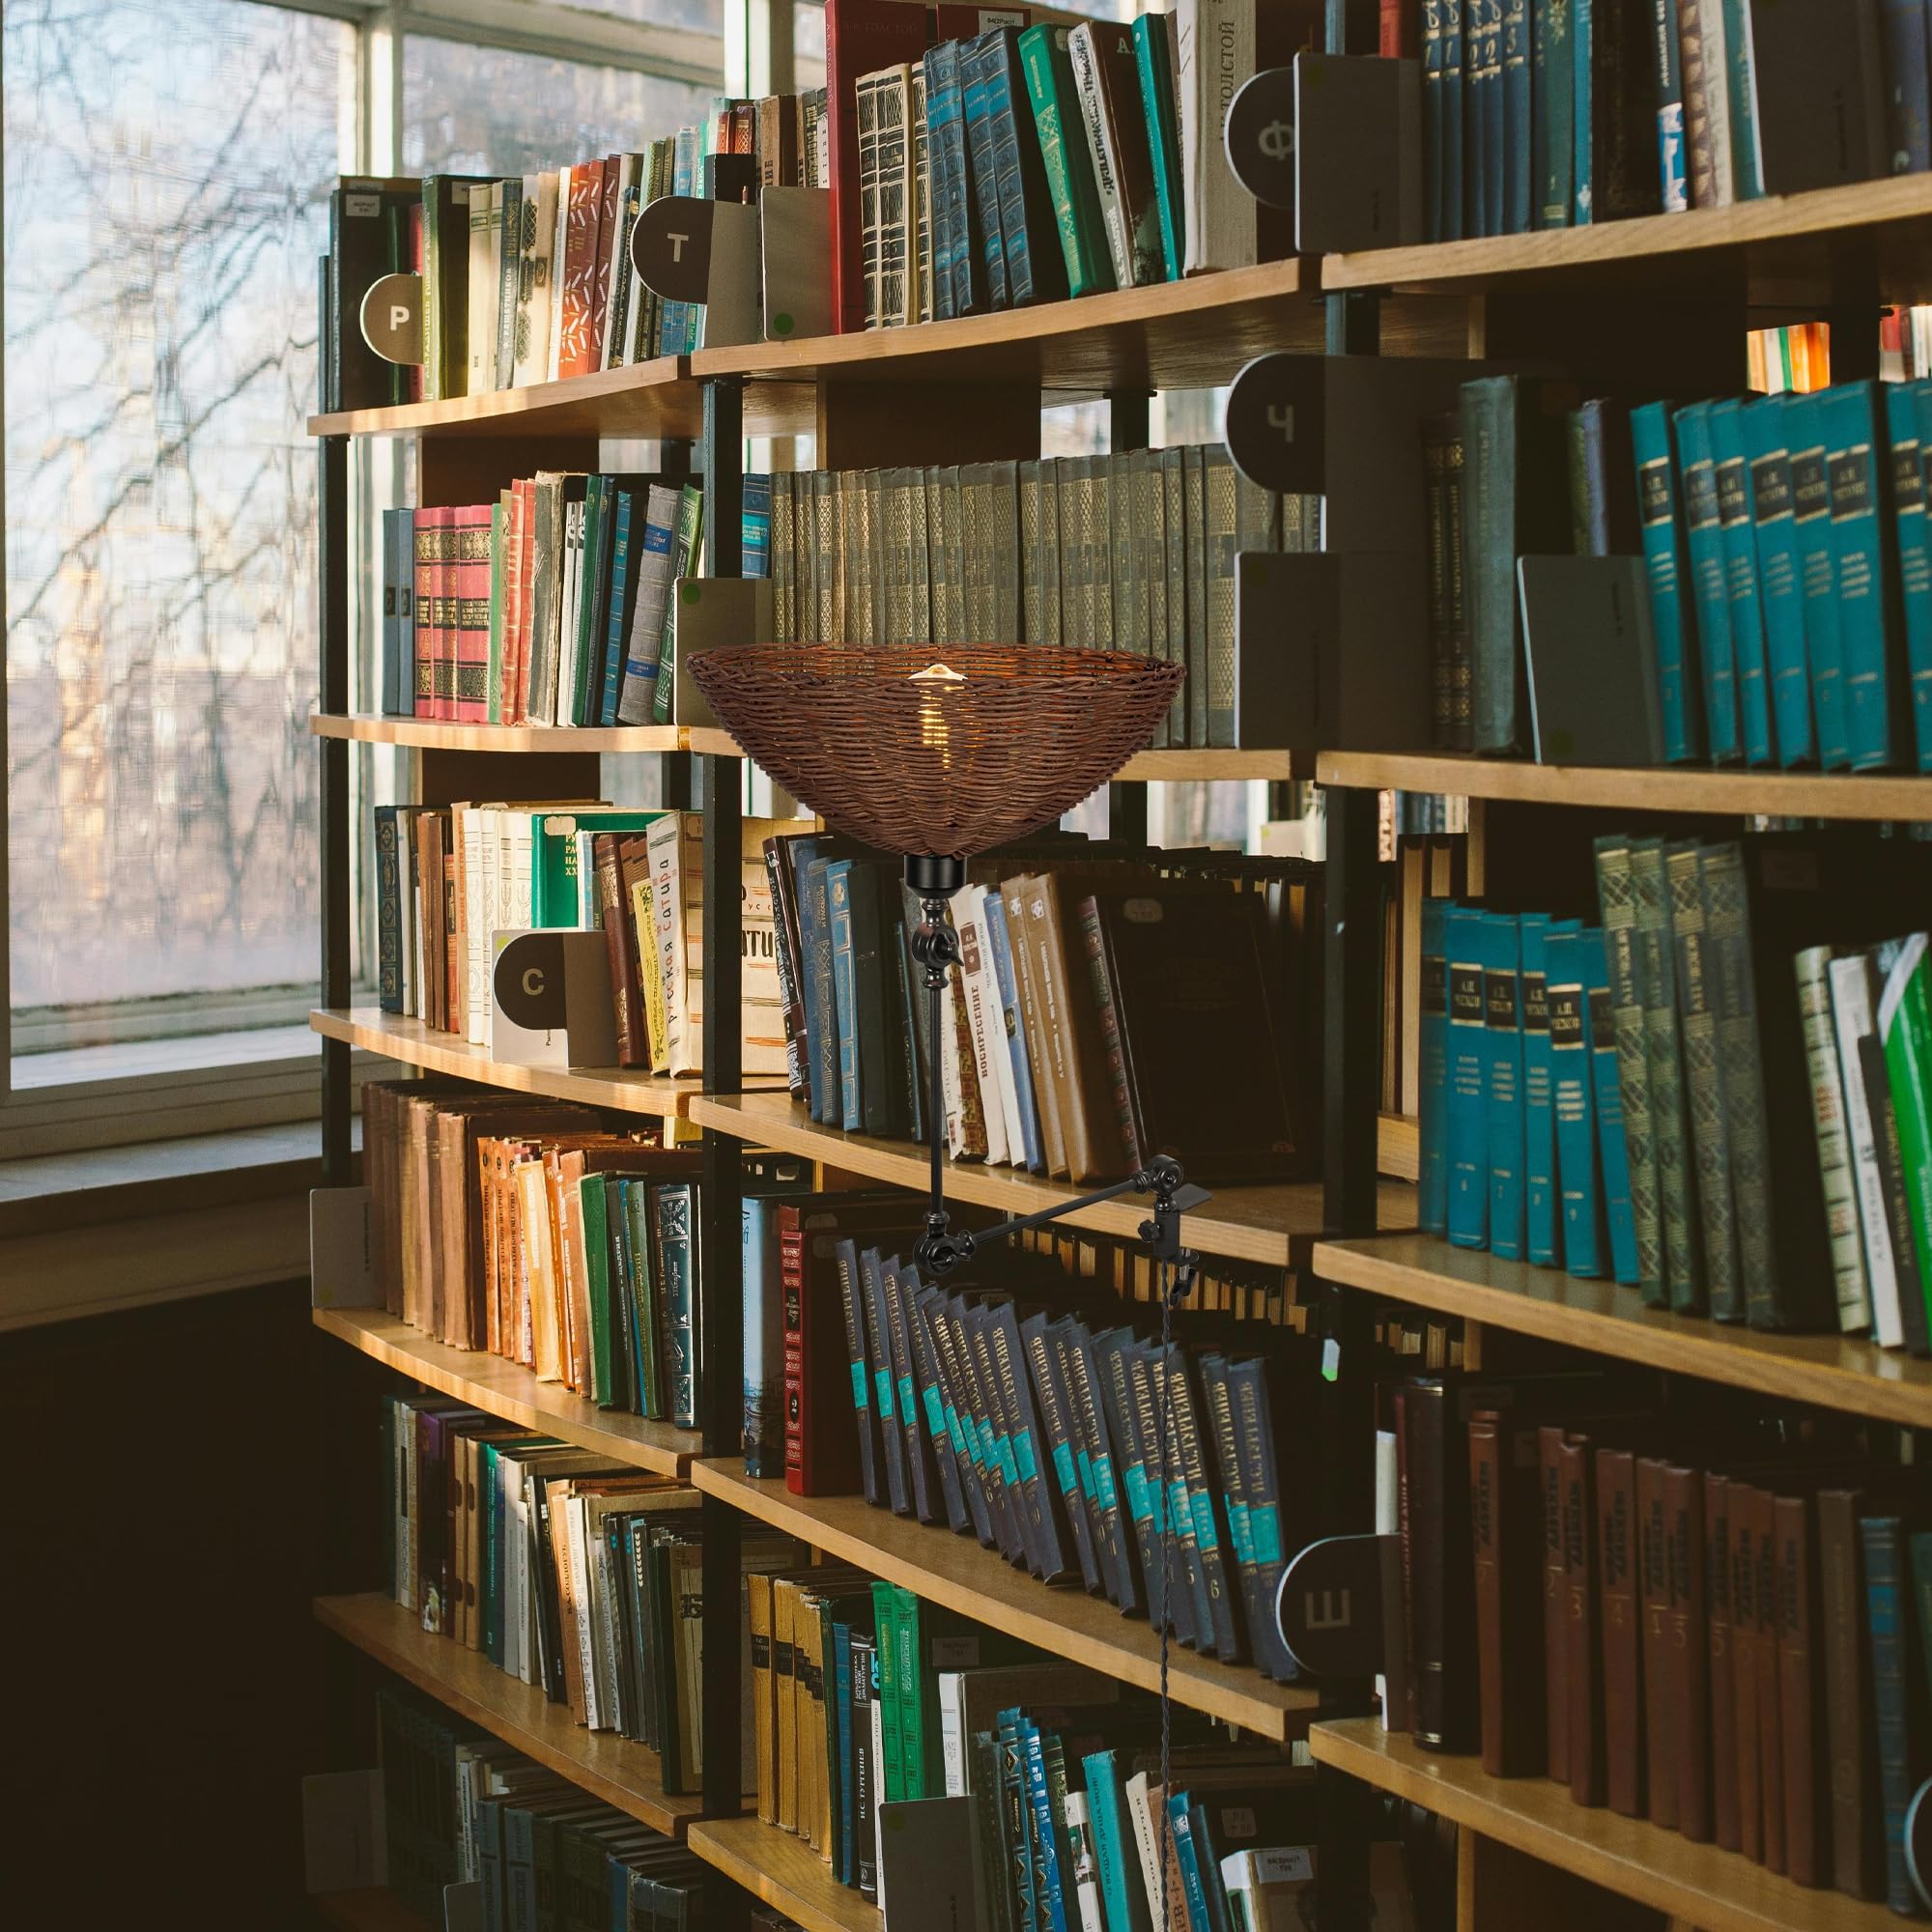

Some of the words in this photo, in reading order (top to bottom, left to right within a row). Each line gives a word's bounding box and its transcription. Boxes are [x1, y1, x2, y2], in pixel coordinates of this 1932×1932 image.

[1258, 119, 1295, 161] Ф
[667, 233, 690, 263] Т
[389, 305, 411, 330] Р
[1266, 404, 1294, 443] Ч
[522, 968, 545, 996] С
[966, 985, 993, 1076] ВОСКРЕСЕНИЕ
[1305, 1587, 1351, 1631] Ш
